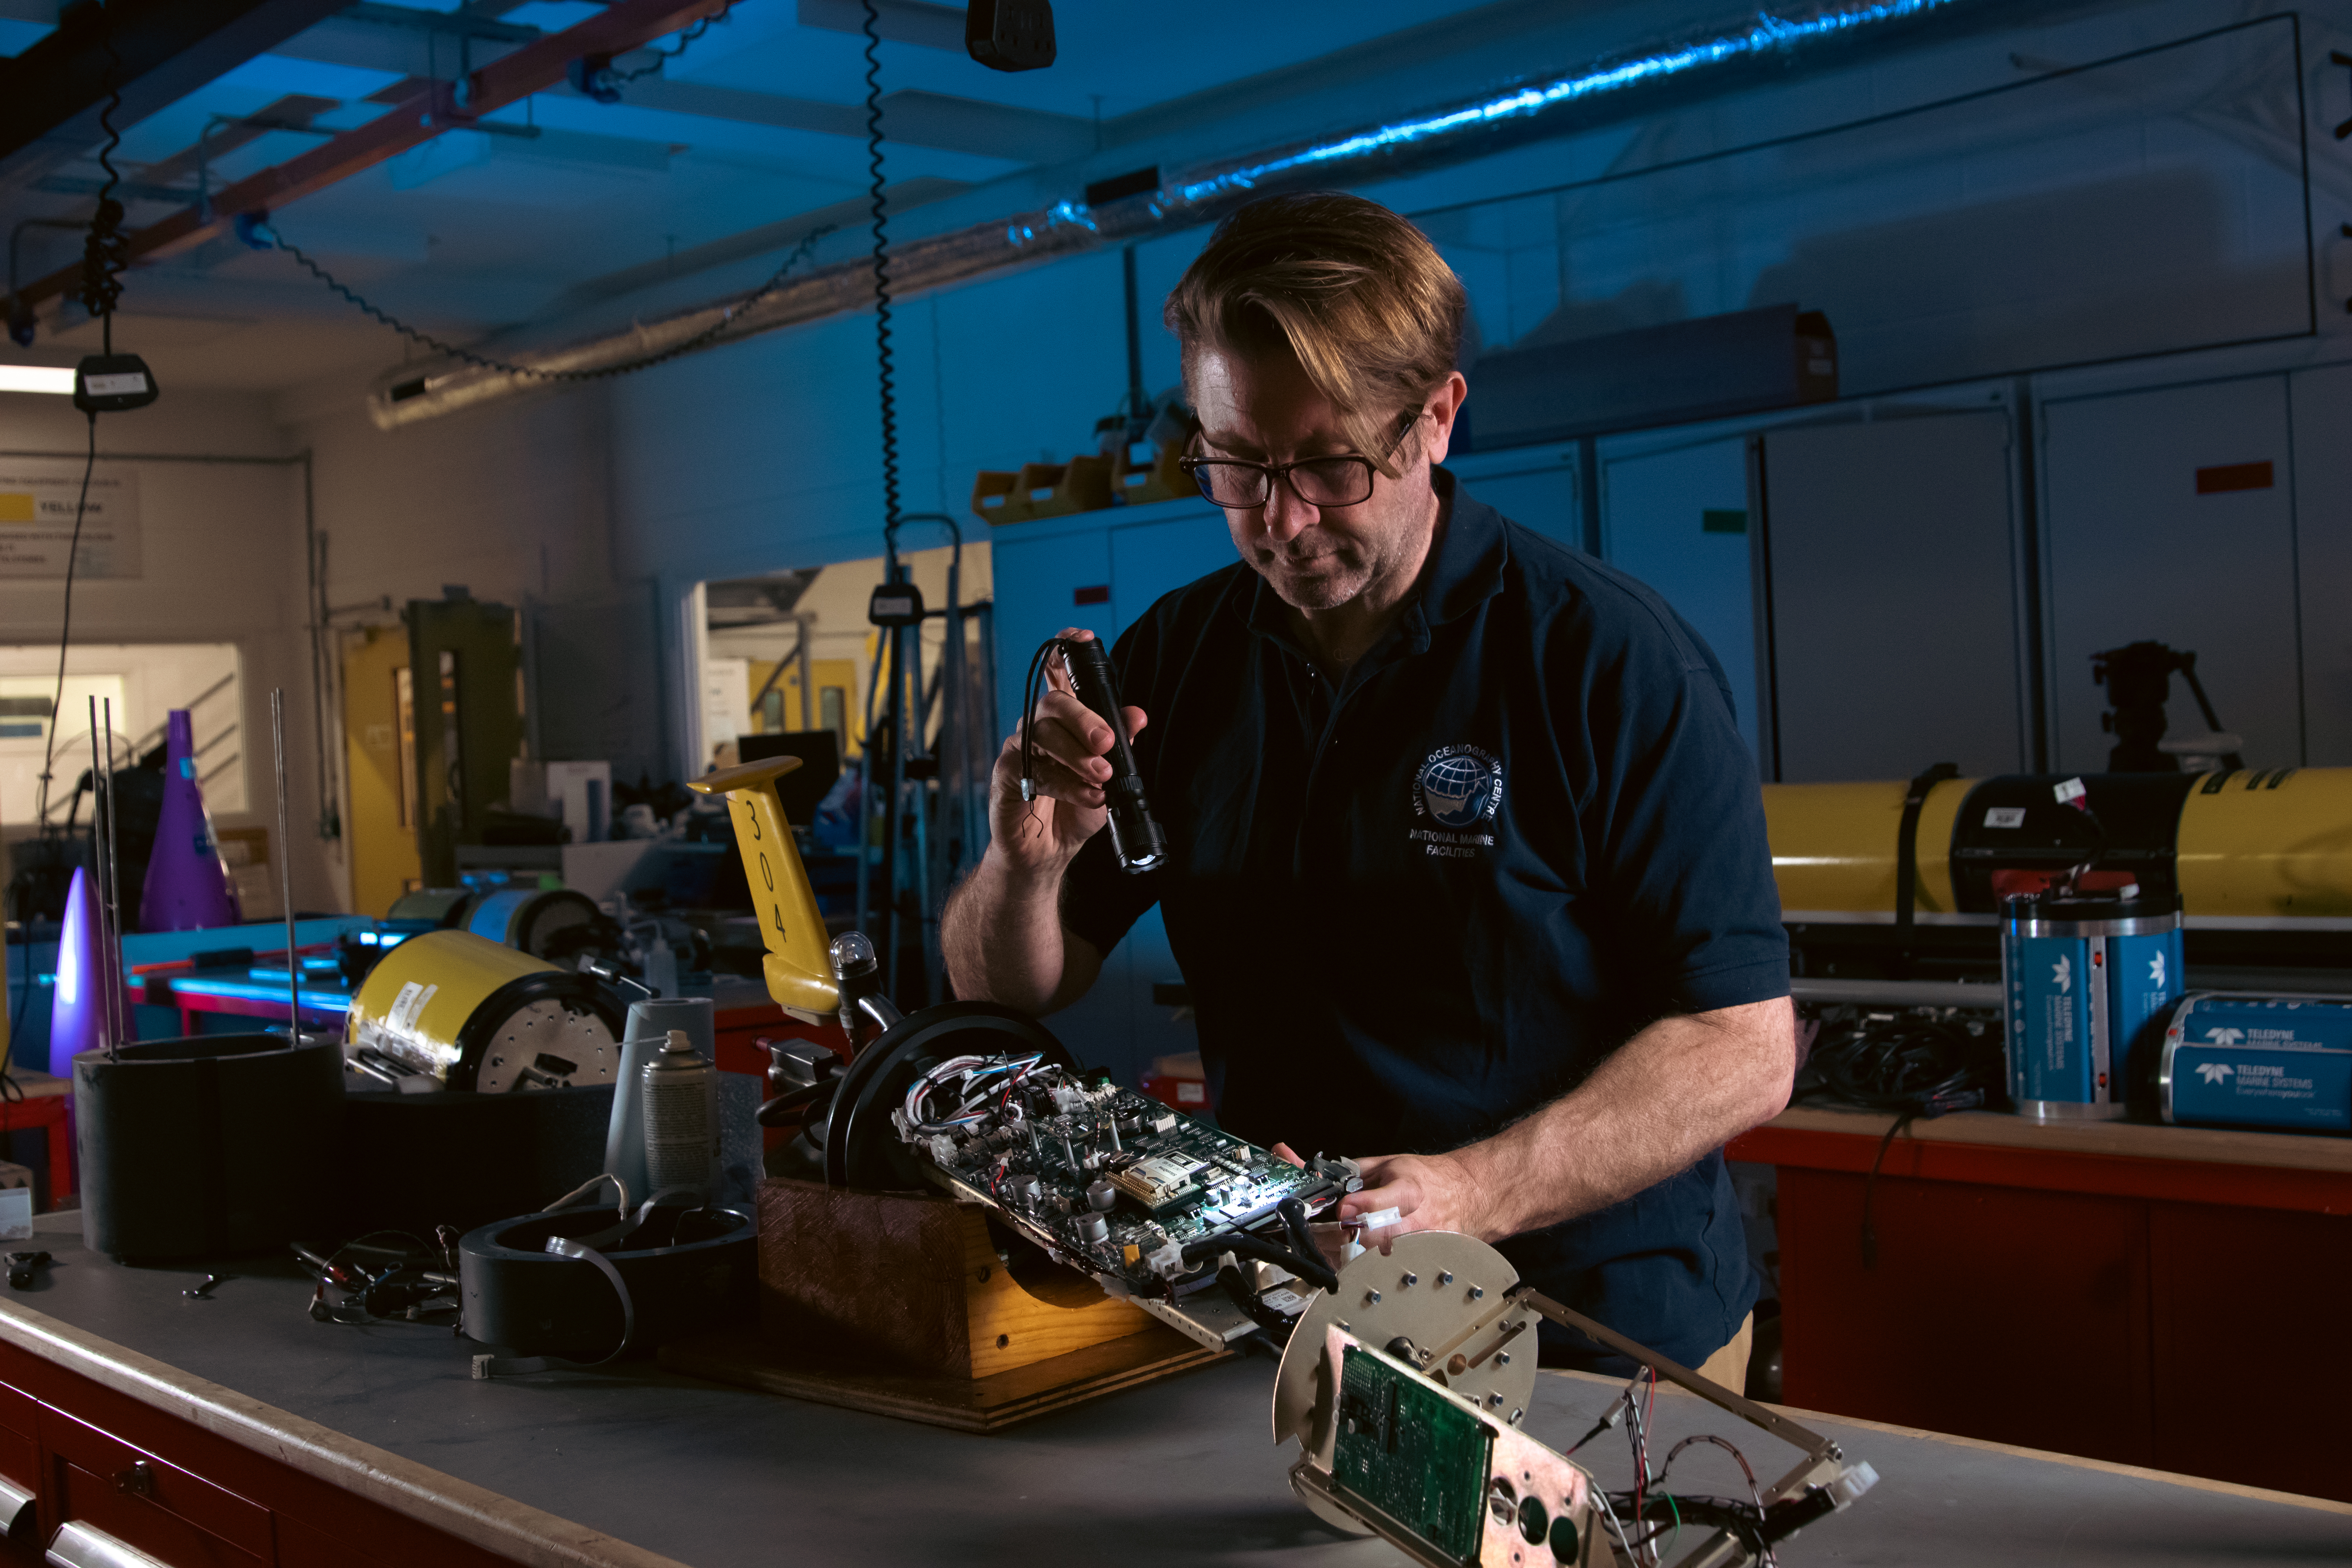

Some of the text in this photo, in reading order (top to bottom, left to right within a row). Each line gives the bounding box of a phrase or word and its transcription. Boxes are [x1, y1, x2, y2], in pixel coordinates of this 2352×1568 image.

[1412, 744, 1502, 822] NATIONAL OCEANOGRAPHY CENTRE
[1410, 828, 1494, 846] NATIONAL MARINE
[1426, 845, 1475, 857] FACILITIES
[746, 800, 786, 943] 304
[2247, 1029, 2294, 1040] TELEDYNE
[2237, 1065, 2284, 1077] TELEDYNE
[2236, 1076, 2313, 1089] MARINE SYSTEMS
